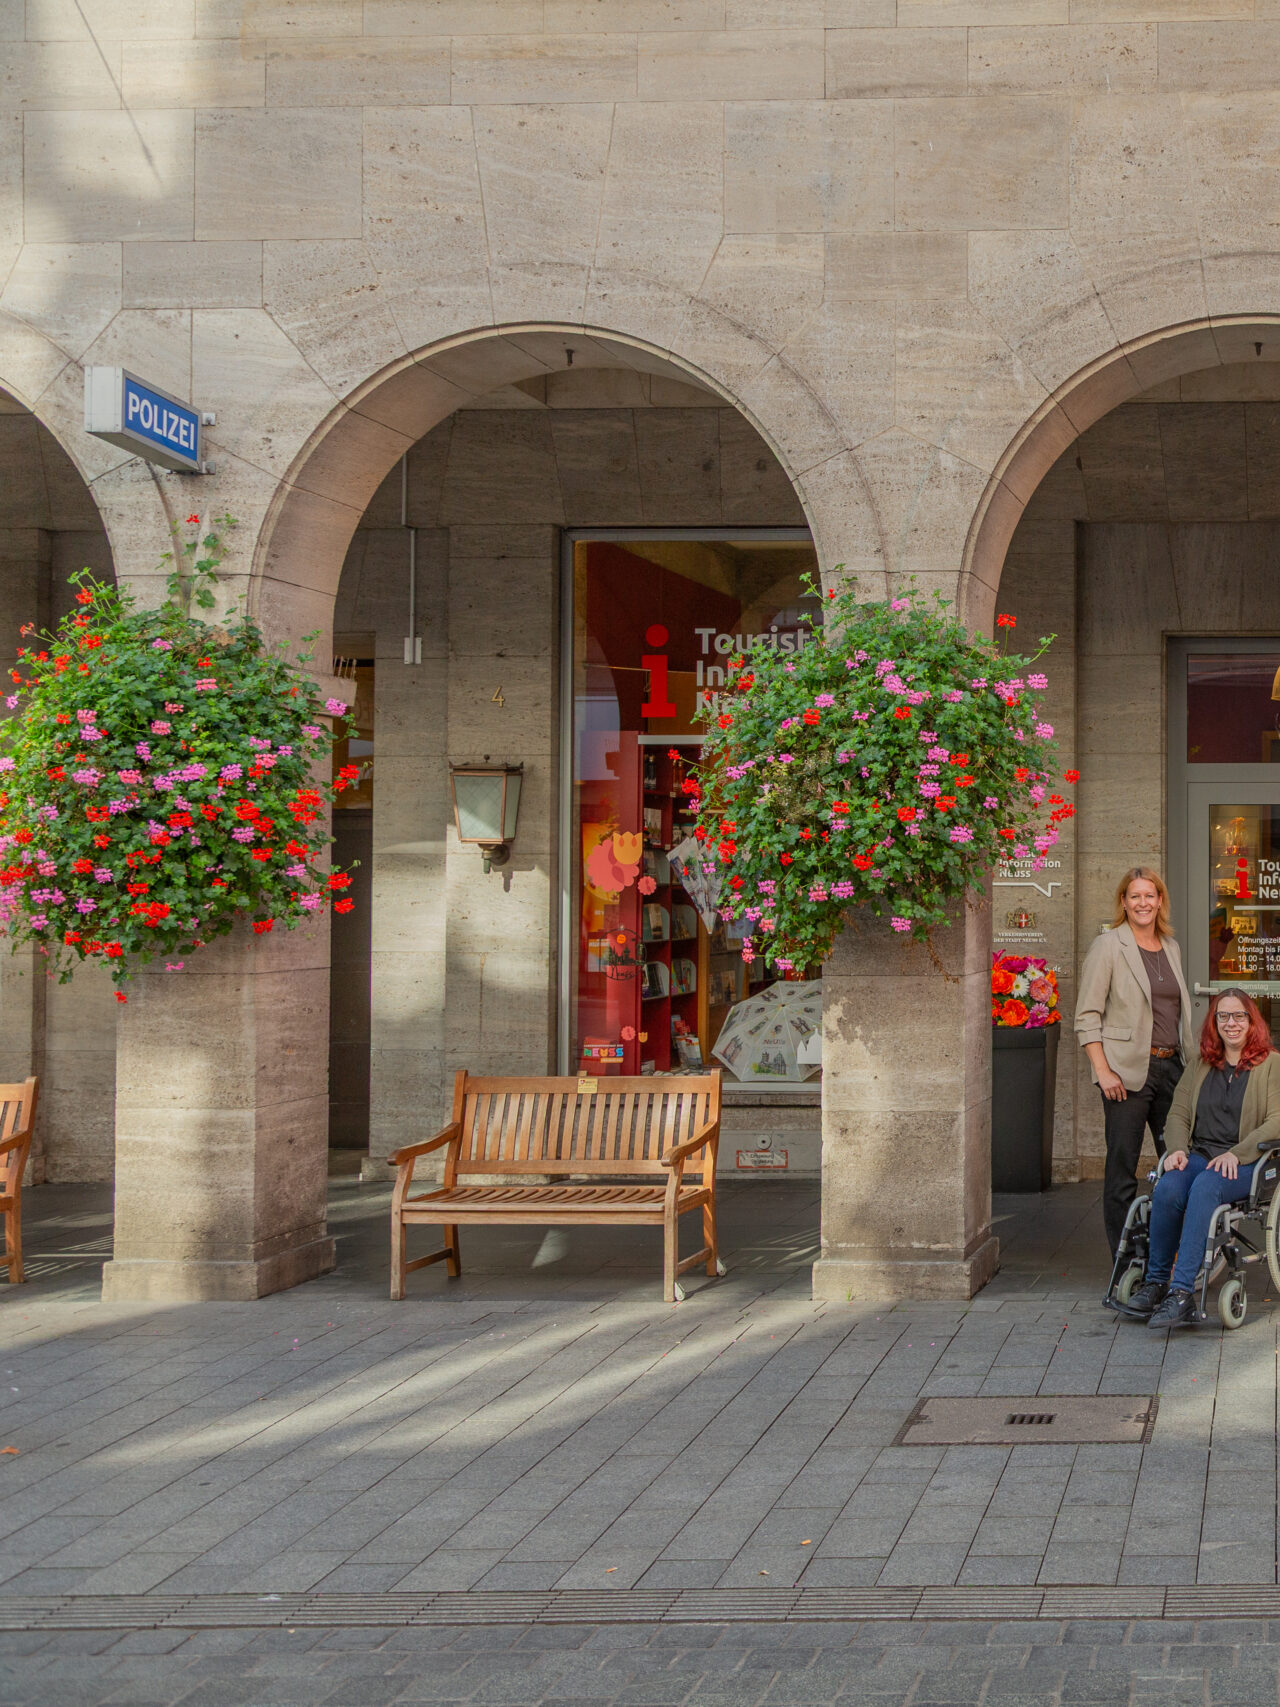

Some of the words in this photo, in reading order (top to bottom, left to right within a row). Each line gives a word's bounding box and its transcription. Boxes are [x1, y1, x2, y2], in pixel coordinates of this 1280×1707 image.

[128, 391, 195, 451] POLIZEI
[490, 685, 505, 708] 4
[1236, 858, 1251, 898] i
[1237, 946, 1264, 954] Montag
[584, 1048, 623, 1057] NEUSS
